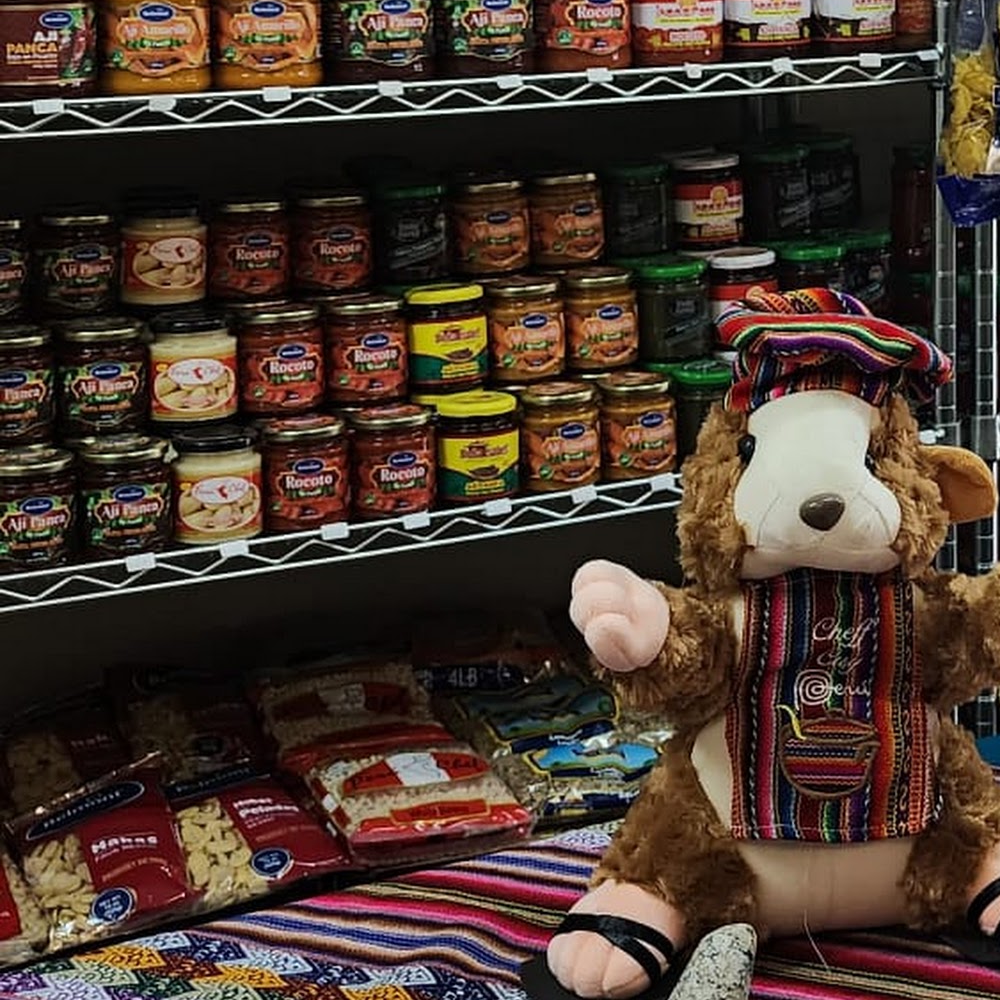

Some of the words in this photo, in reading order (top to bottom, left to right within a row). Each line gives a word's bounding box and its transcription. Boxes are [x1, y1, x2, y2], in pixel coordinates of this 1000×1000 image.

[380, 466, 425, 480] Rocoto
[285, 474, 333, 488] Rocoto
[813, 616, 880, 648] Chef
